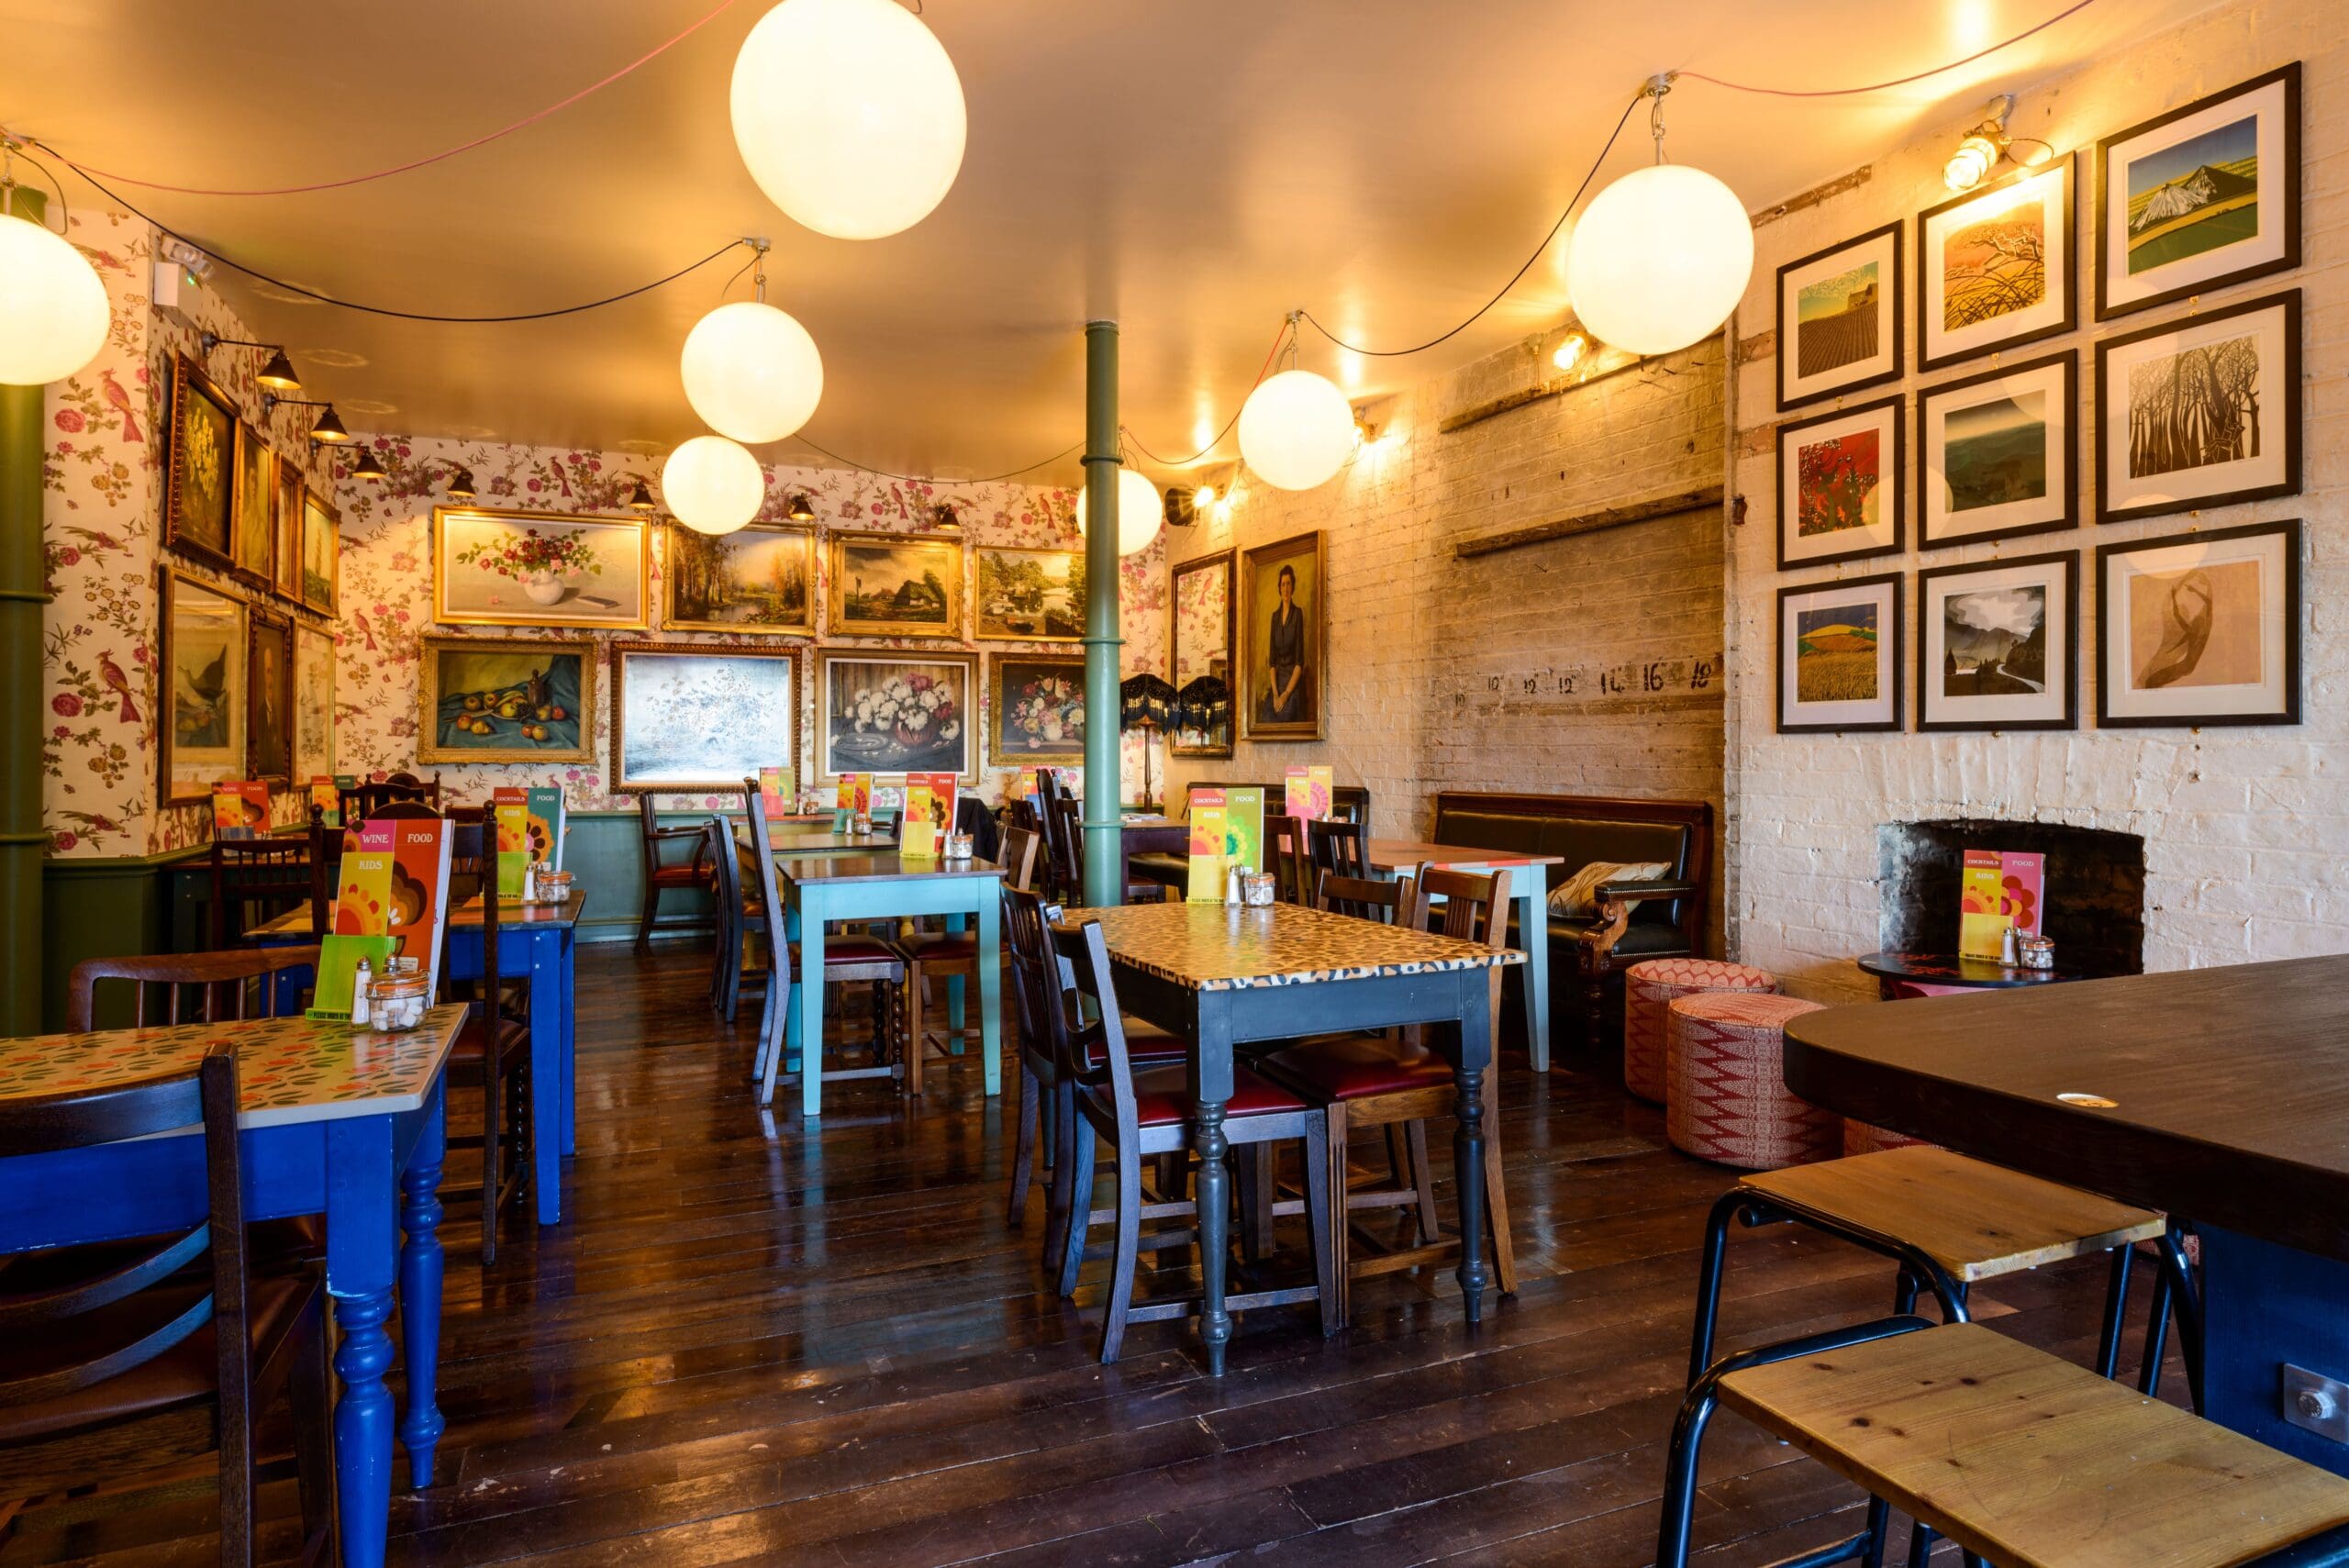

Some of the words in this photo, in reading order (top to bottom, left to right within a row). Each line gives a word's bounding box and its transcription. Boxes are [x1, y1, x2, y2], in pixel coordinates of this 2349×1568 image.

[1234, 795, 1256, 803] FOOD
[362, 833, 389, 844] WINE
[406, 833, 433, 843] FOOD
[358, 860, 383, 870] KIDS
